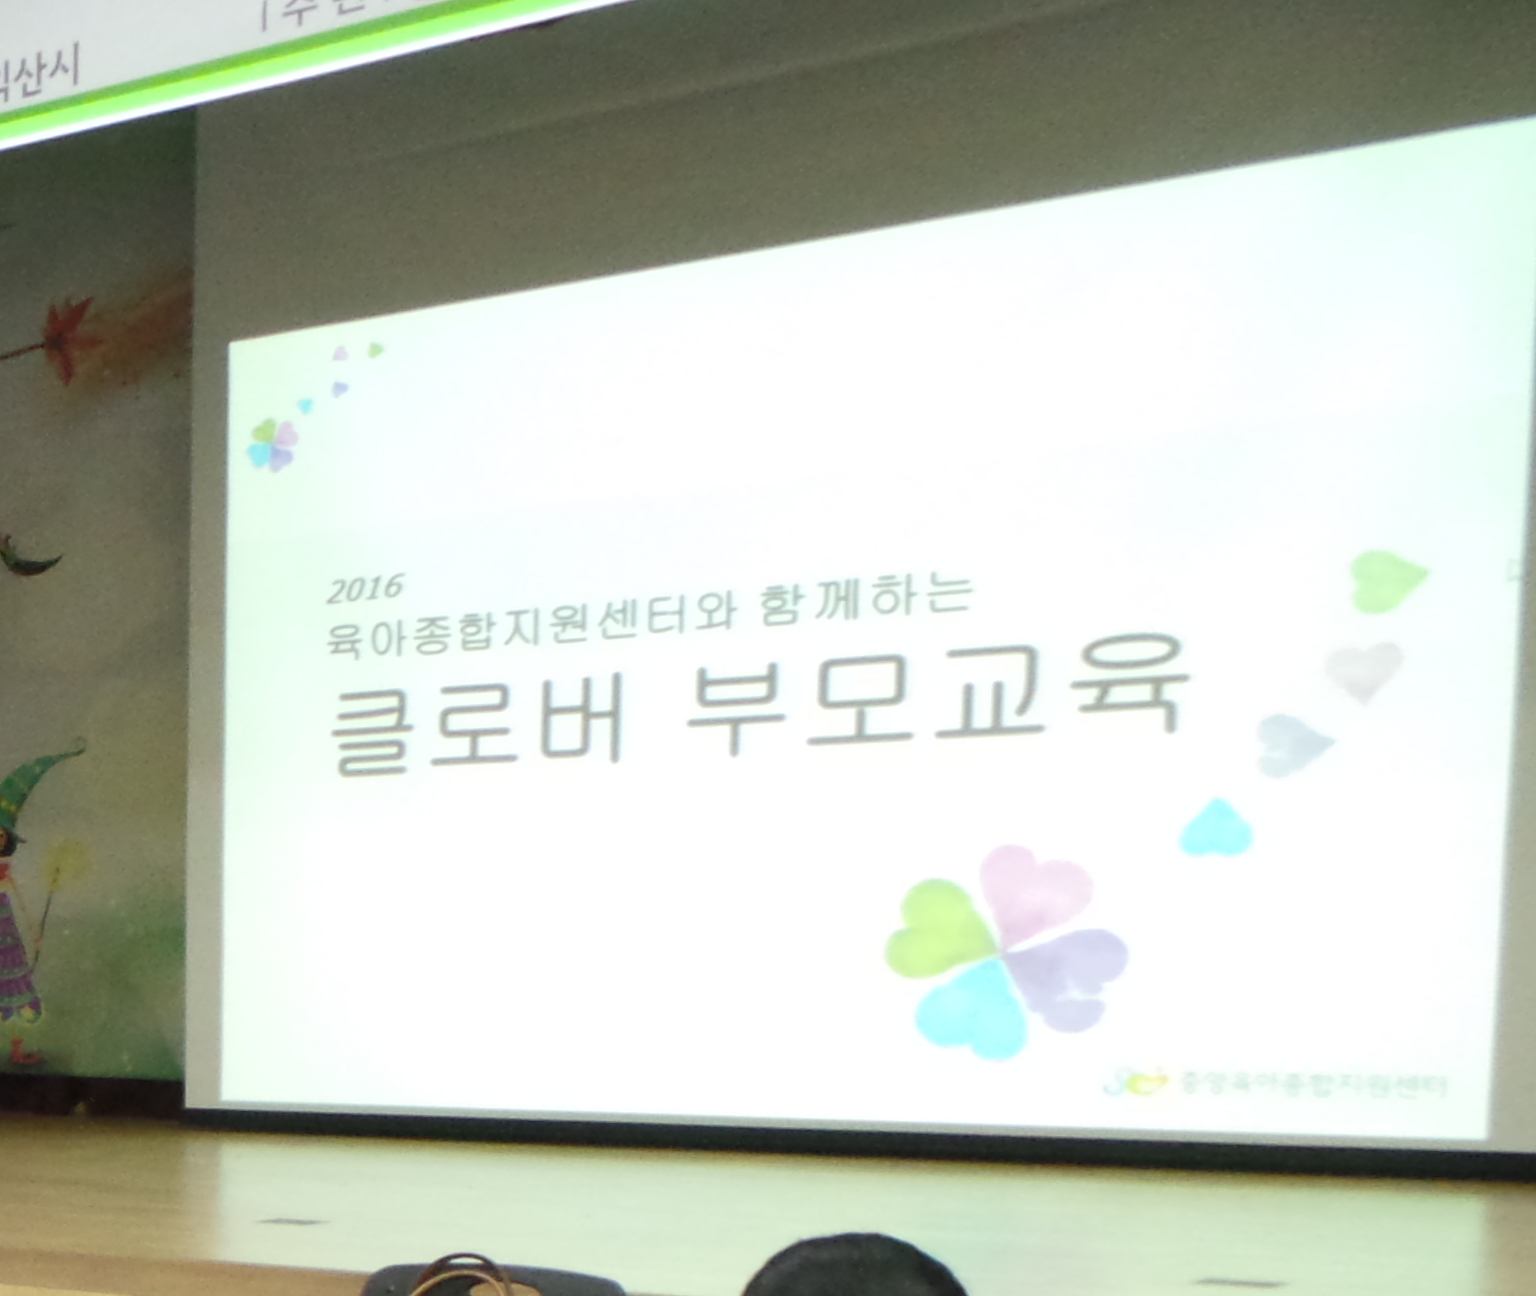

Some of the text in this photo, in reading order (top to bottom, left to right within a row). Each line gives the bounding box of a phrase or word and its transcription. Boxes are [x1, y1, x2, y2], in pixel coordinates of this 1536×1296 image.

[326, 572, 405, 605] 2016
[327, 571, 974, 661] 육아종합지원센터와 함께하는
[331, 632, 1191, 778] 클로버 부모교육
